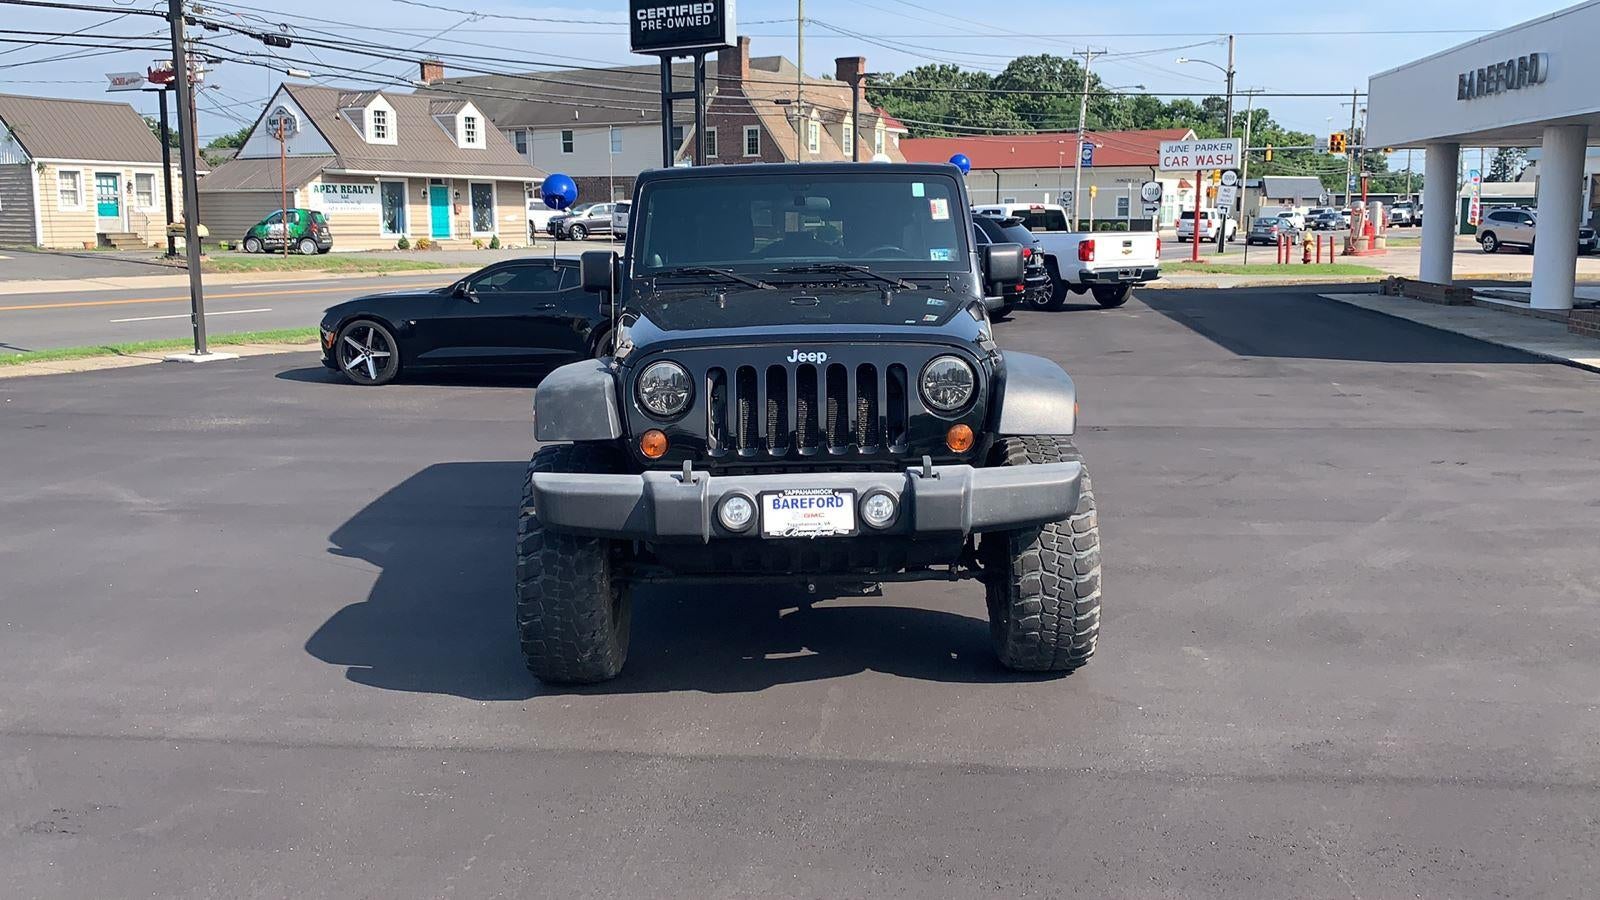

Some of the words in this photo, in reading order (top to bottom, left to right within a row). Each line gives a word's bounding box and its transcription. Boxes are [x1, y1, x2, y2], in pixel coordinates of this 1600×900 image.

[637, 2, 715, 20] CERTIFIED
[640, 15, 711, 31] PRE-OWNED
[1457, 53, 1548, 100] BAREFORD
[1165, 144, 1190, 153] JUNE
[1194, 143, 1233, 152] PARKER
[1164, 156, 1189, 167] CAR
[1195, 154, 1234, 166] WASH
[313, 184, 338, 194] APEX
[340, 184, 375, 194] REALTY
[1144, 187, 1159, 196] 1010
[786, 349, 827, 364] Jeep
[784, 488, 834, 496] TAPPAHANNOCK
[772, 496, 844, 510] BAREFORD
